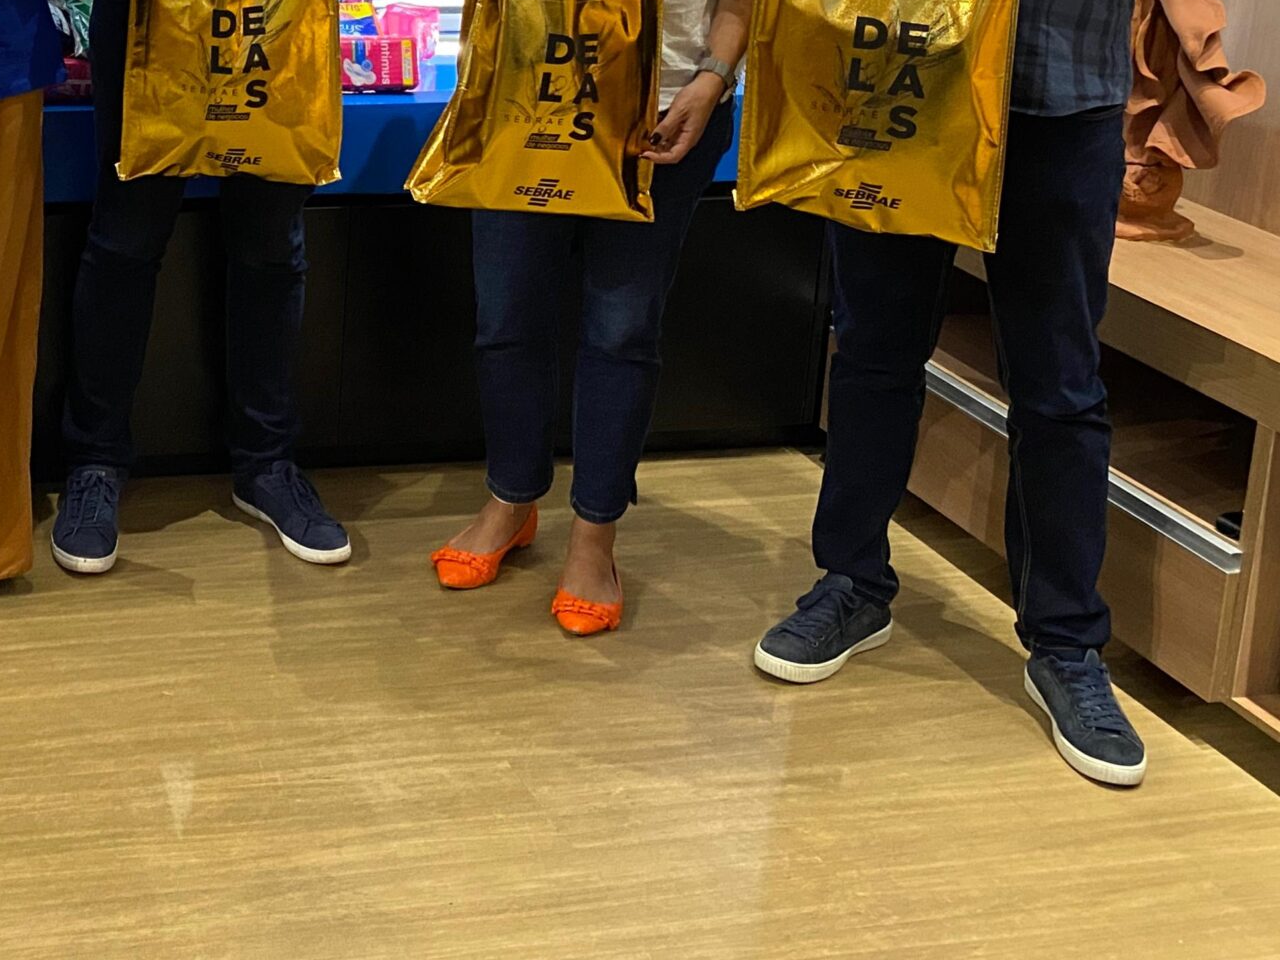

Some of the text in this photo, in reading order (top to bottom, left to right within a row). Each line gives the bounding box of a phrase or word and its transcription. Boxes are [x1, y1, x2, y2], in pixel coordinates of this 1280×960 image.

[204, 151, 262, 166] SEBRAE
[513, 185, 575, 200] SEBRAE
[833, 188, 902, 210] SEBRAE
